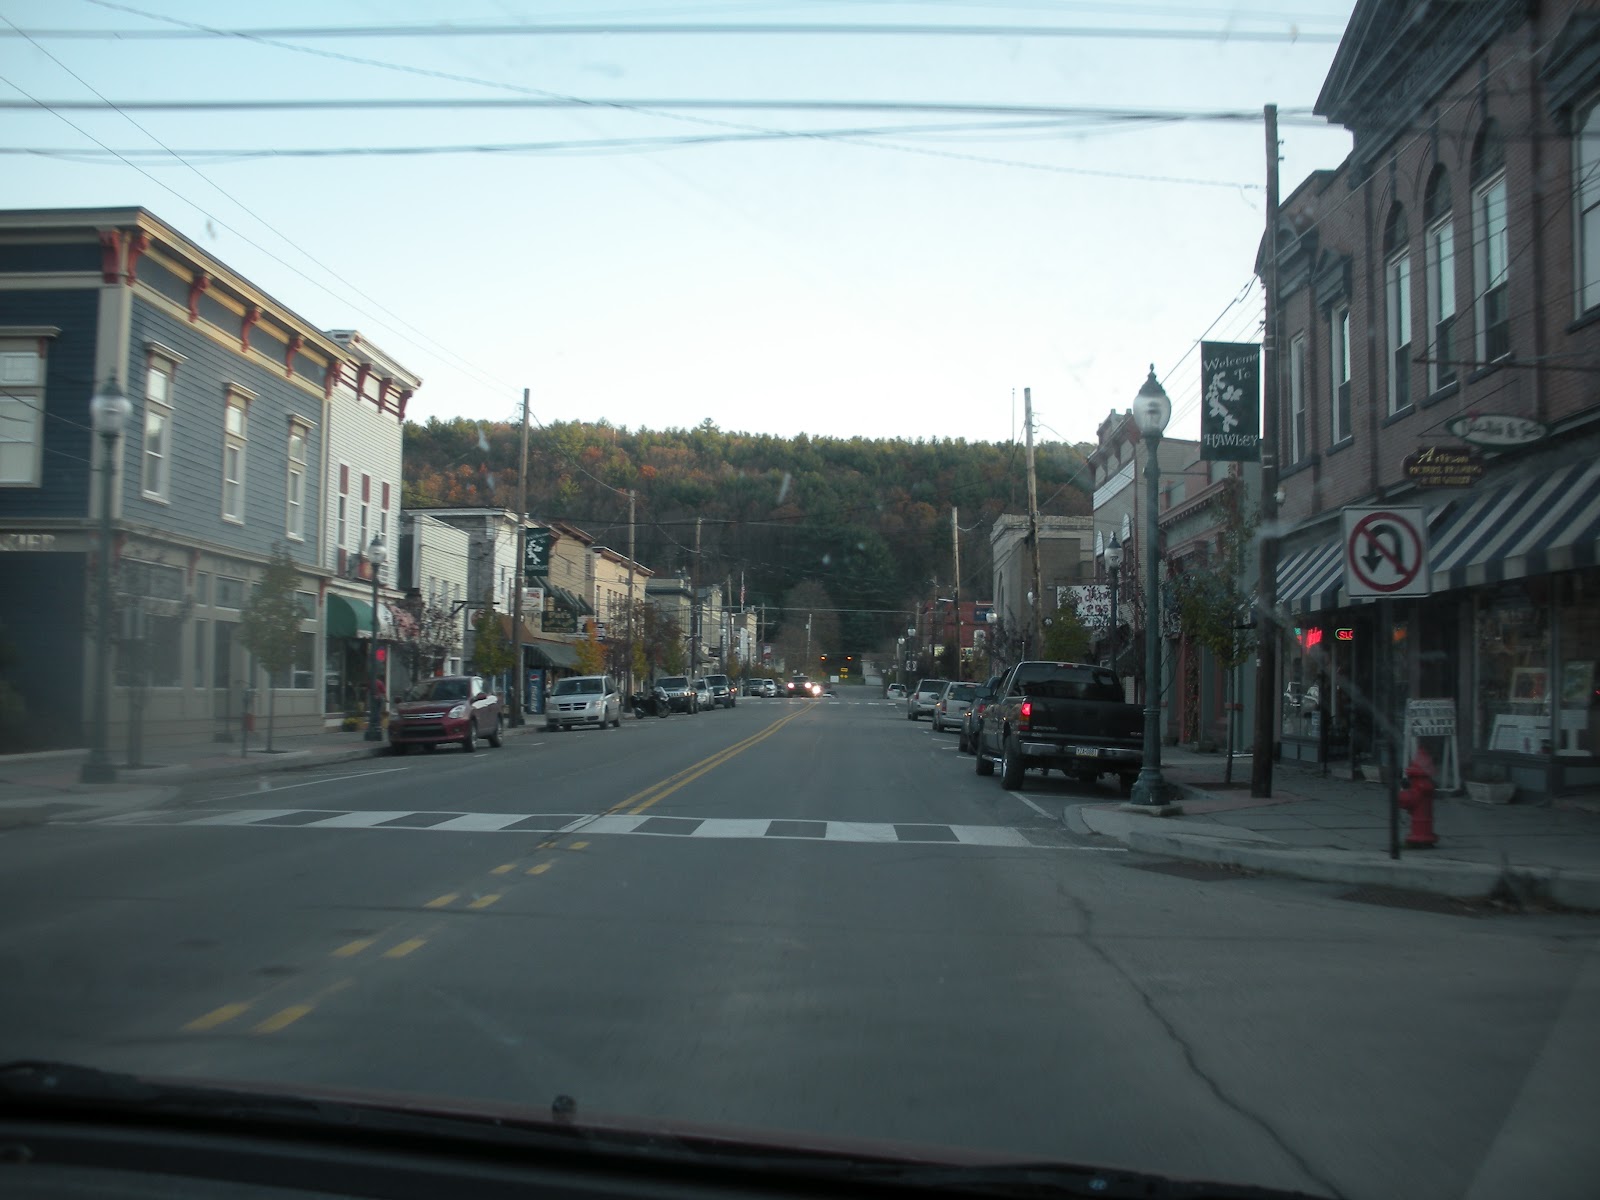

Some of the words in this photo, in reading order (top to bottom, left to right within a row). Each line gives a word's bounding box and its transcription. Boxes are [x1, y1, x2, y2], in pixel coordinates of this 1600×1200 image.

[1203, 353, 1259, 372] Welcome
[1234, 368, 1251, 381] To
[1204, 434, 1259, 449] HAWLEY
